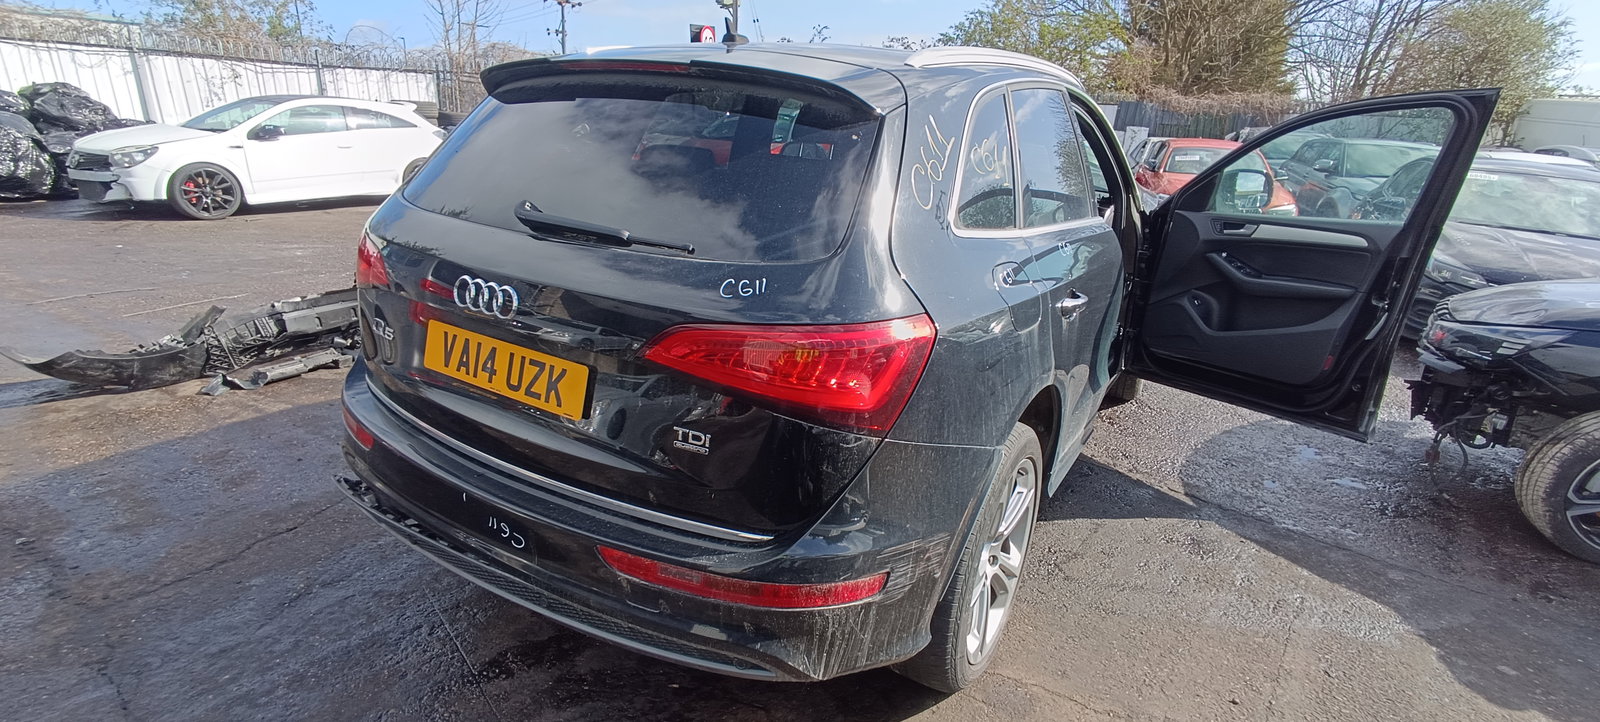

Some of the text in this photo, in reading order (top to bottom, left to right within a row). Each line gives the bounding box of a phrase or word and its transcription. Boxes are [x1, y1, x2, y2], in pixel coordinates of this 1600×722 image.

[372, 317, 395, 340] Q5
[443, 331, 567, 408] VA14 UZK
